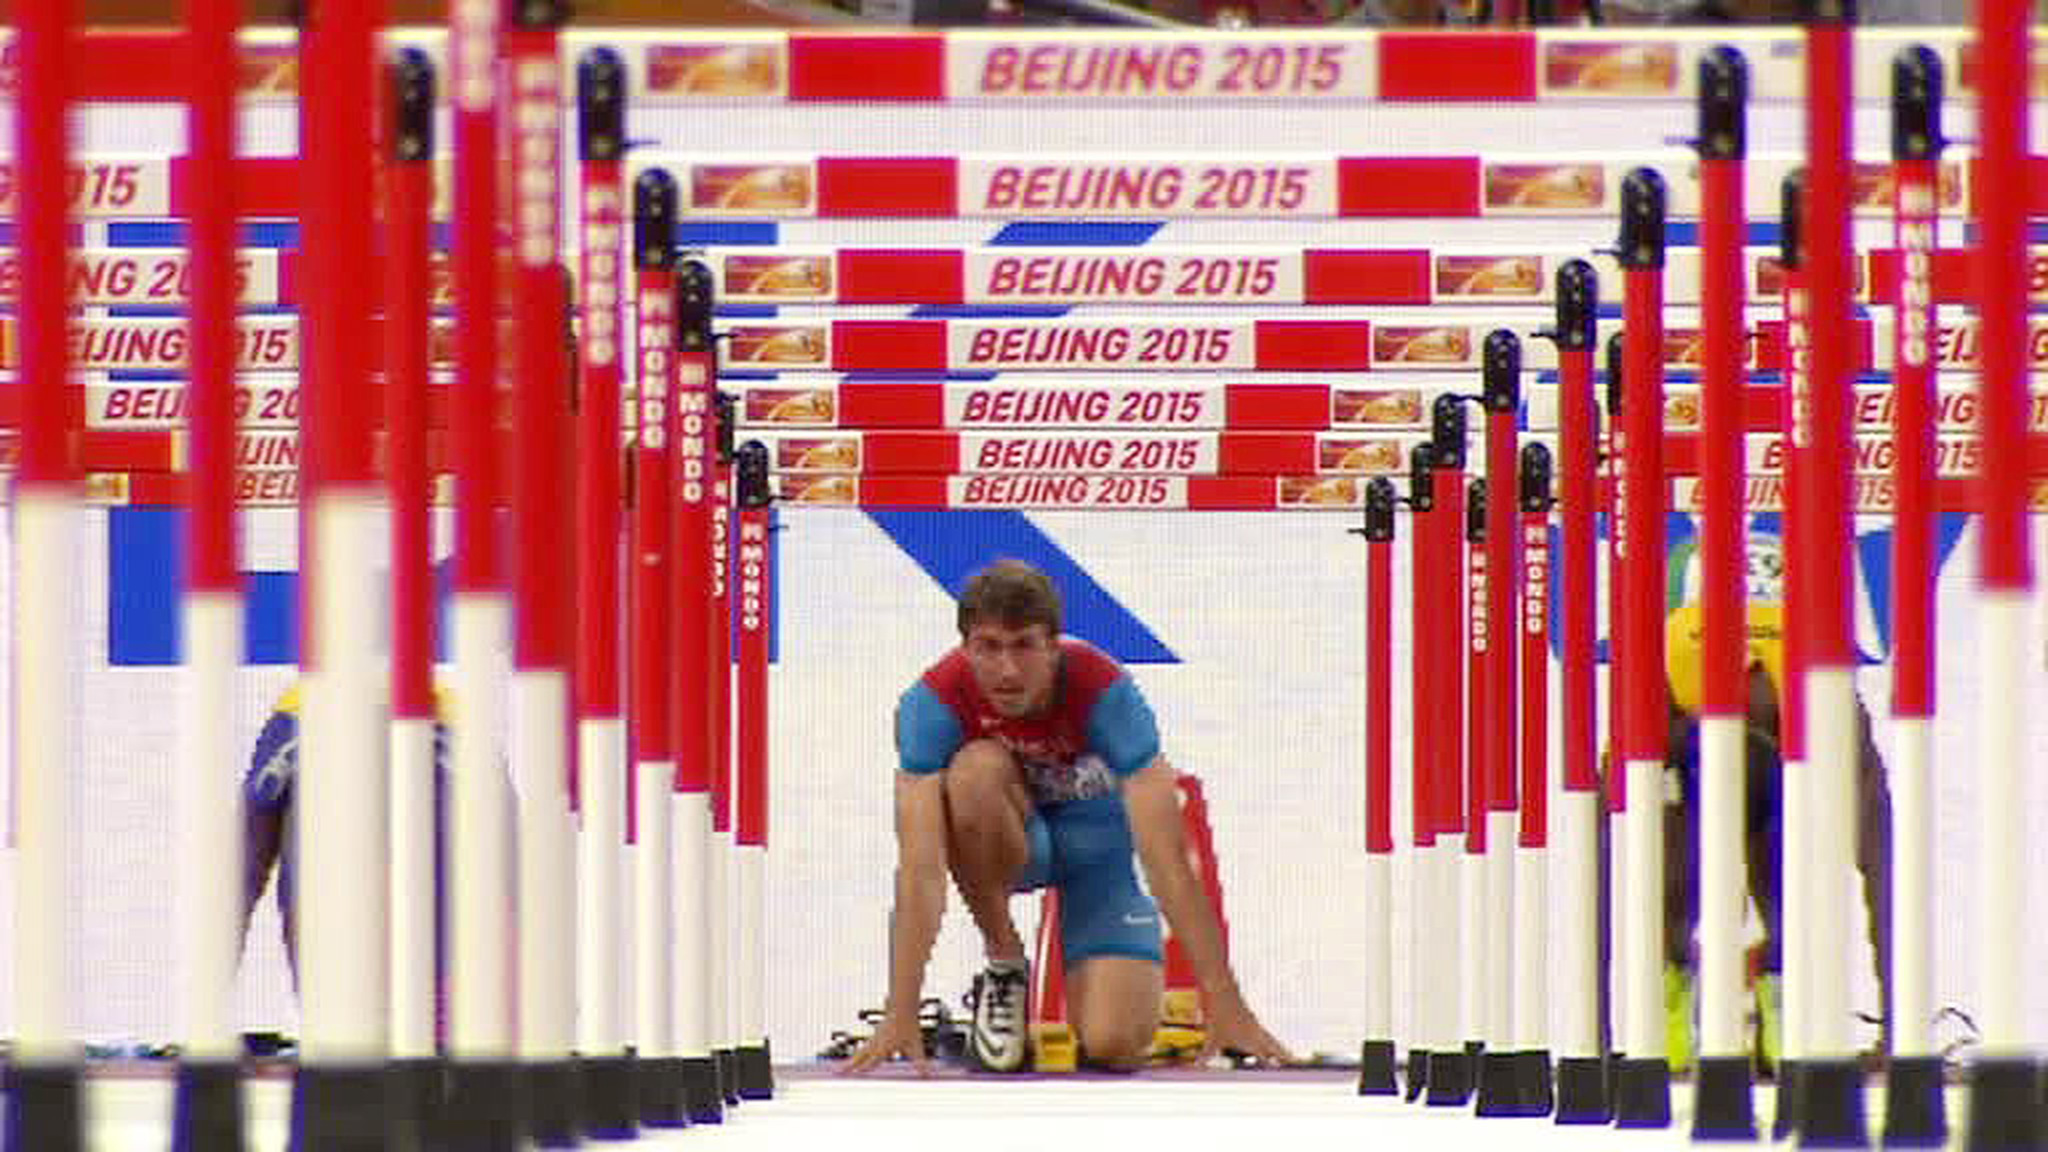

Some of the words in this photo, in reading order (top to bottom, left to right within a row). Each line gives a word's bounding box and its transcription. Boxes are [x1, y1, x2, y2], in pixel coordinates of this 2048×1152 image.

[981, 46, 1204, 91] BEIJING
[1216, 46, 1346, 91] 2015
[985, 167, 1184, 209] BEIJING
[1193, 167, 1309, 209] 2015
[988, 259, 1166, 295] BEIJING
[1174, 259, 1278, 295] 2015
[969, 328, 1130, 362] BEIJING
[1137, 328, 1232, 362] 2015
[642, 323, 672, 450] MONDO
[962, 392, 1109, 421] BEIJING
[1117, 392, 1204, 421] 2015
[680, 391, 706, 503] MONDO
[977, 440, 1112, 468] BEIJING
[1121, 440, 1199, 468] 2015
[964, 478, 1087, 502] BEIJING
[1091, 478, 1168, 502] 2015
[742, 544, 765, 631] MONDO
[1525, 547, 1547, 634] MONDO
